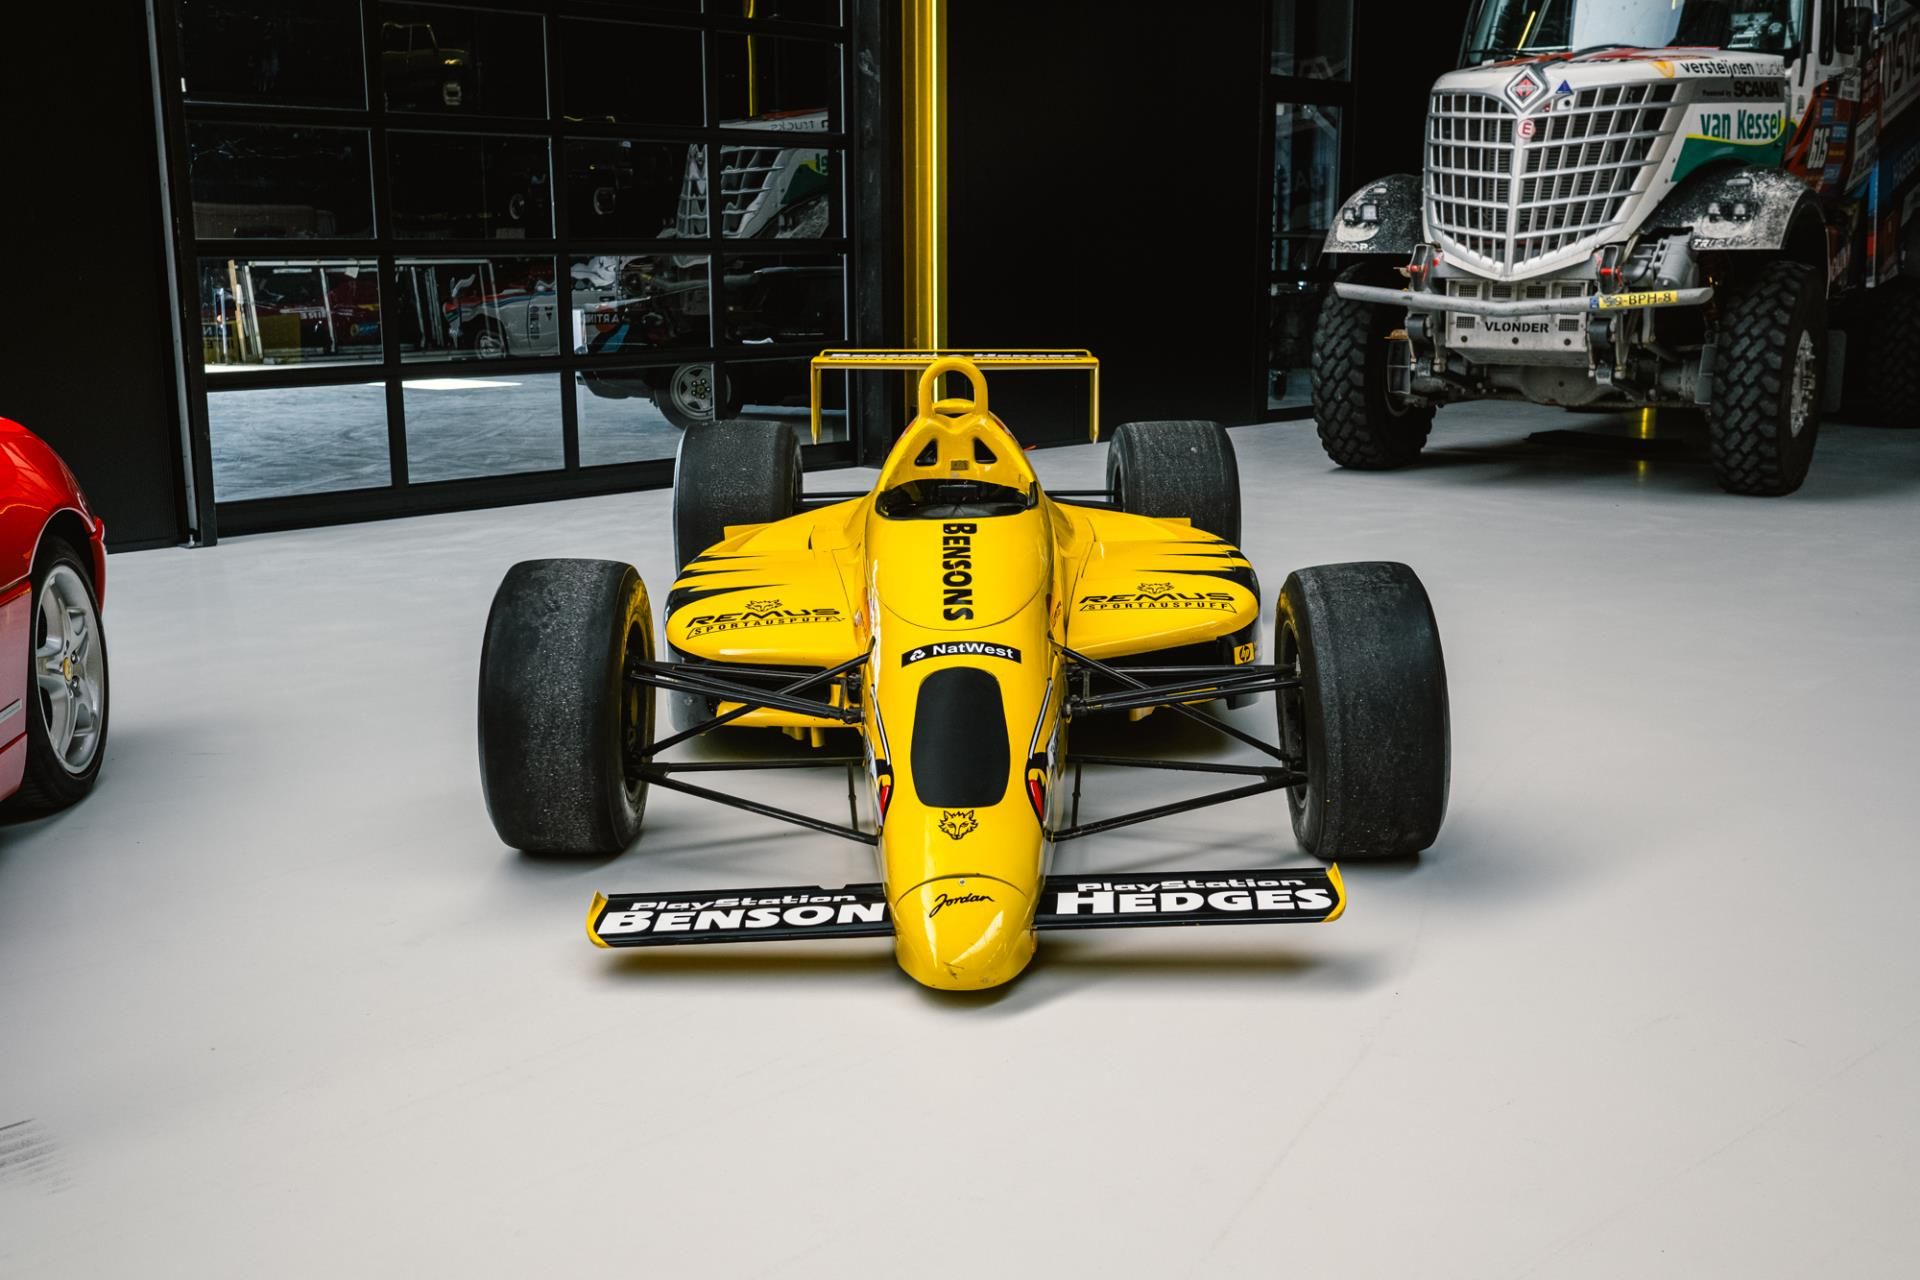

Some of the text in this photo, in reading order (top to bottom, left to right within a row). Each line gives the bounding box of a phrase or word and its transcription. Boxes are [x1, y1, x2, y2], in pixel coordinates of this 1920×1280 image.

[1733, 81, 1780, 98] SCANIA
[1522, 122, 1532, 136] E
[1700, 109, 1783, 140] van Kessel
[1484, 320, 1549, 334] VLONDER
[942, 523, 978, 621] BENSONS
[1079, 592, 1235, 604] REMUS
[1088, 601, 1228, 611] SPORTAUSPUFF
[686, 608, 841, 629] REMUS
[694, 616, 832, 635] SPORTAUSPUFF
[932, 642, 1014, 659] NatWest
[1076, 878, 1307, 892] PlayStation
[630, 894, 857, 912] PlayStation
[928, 893, 996, 919] Jordan
[1055, 888, 1333, 915] HEDGES
[597, 902, 887, 935] BENSON
